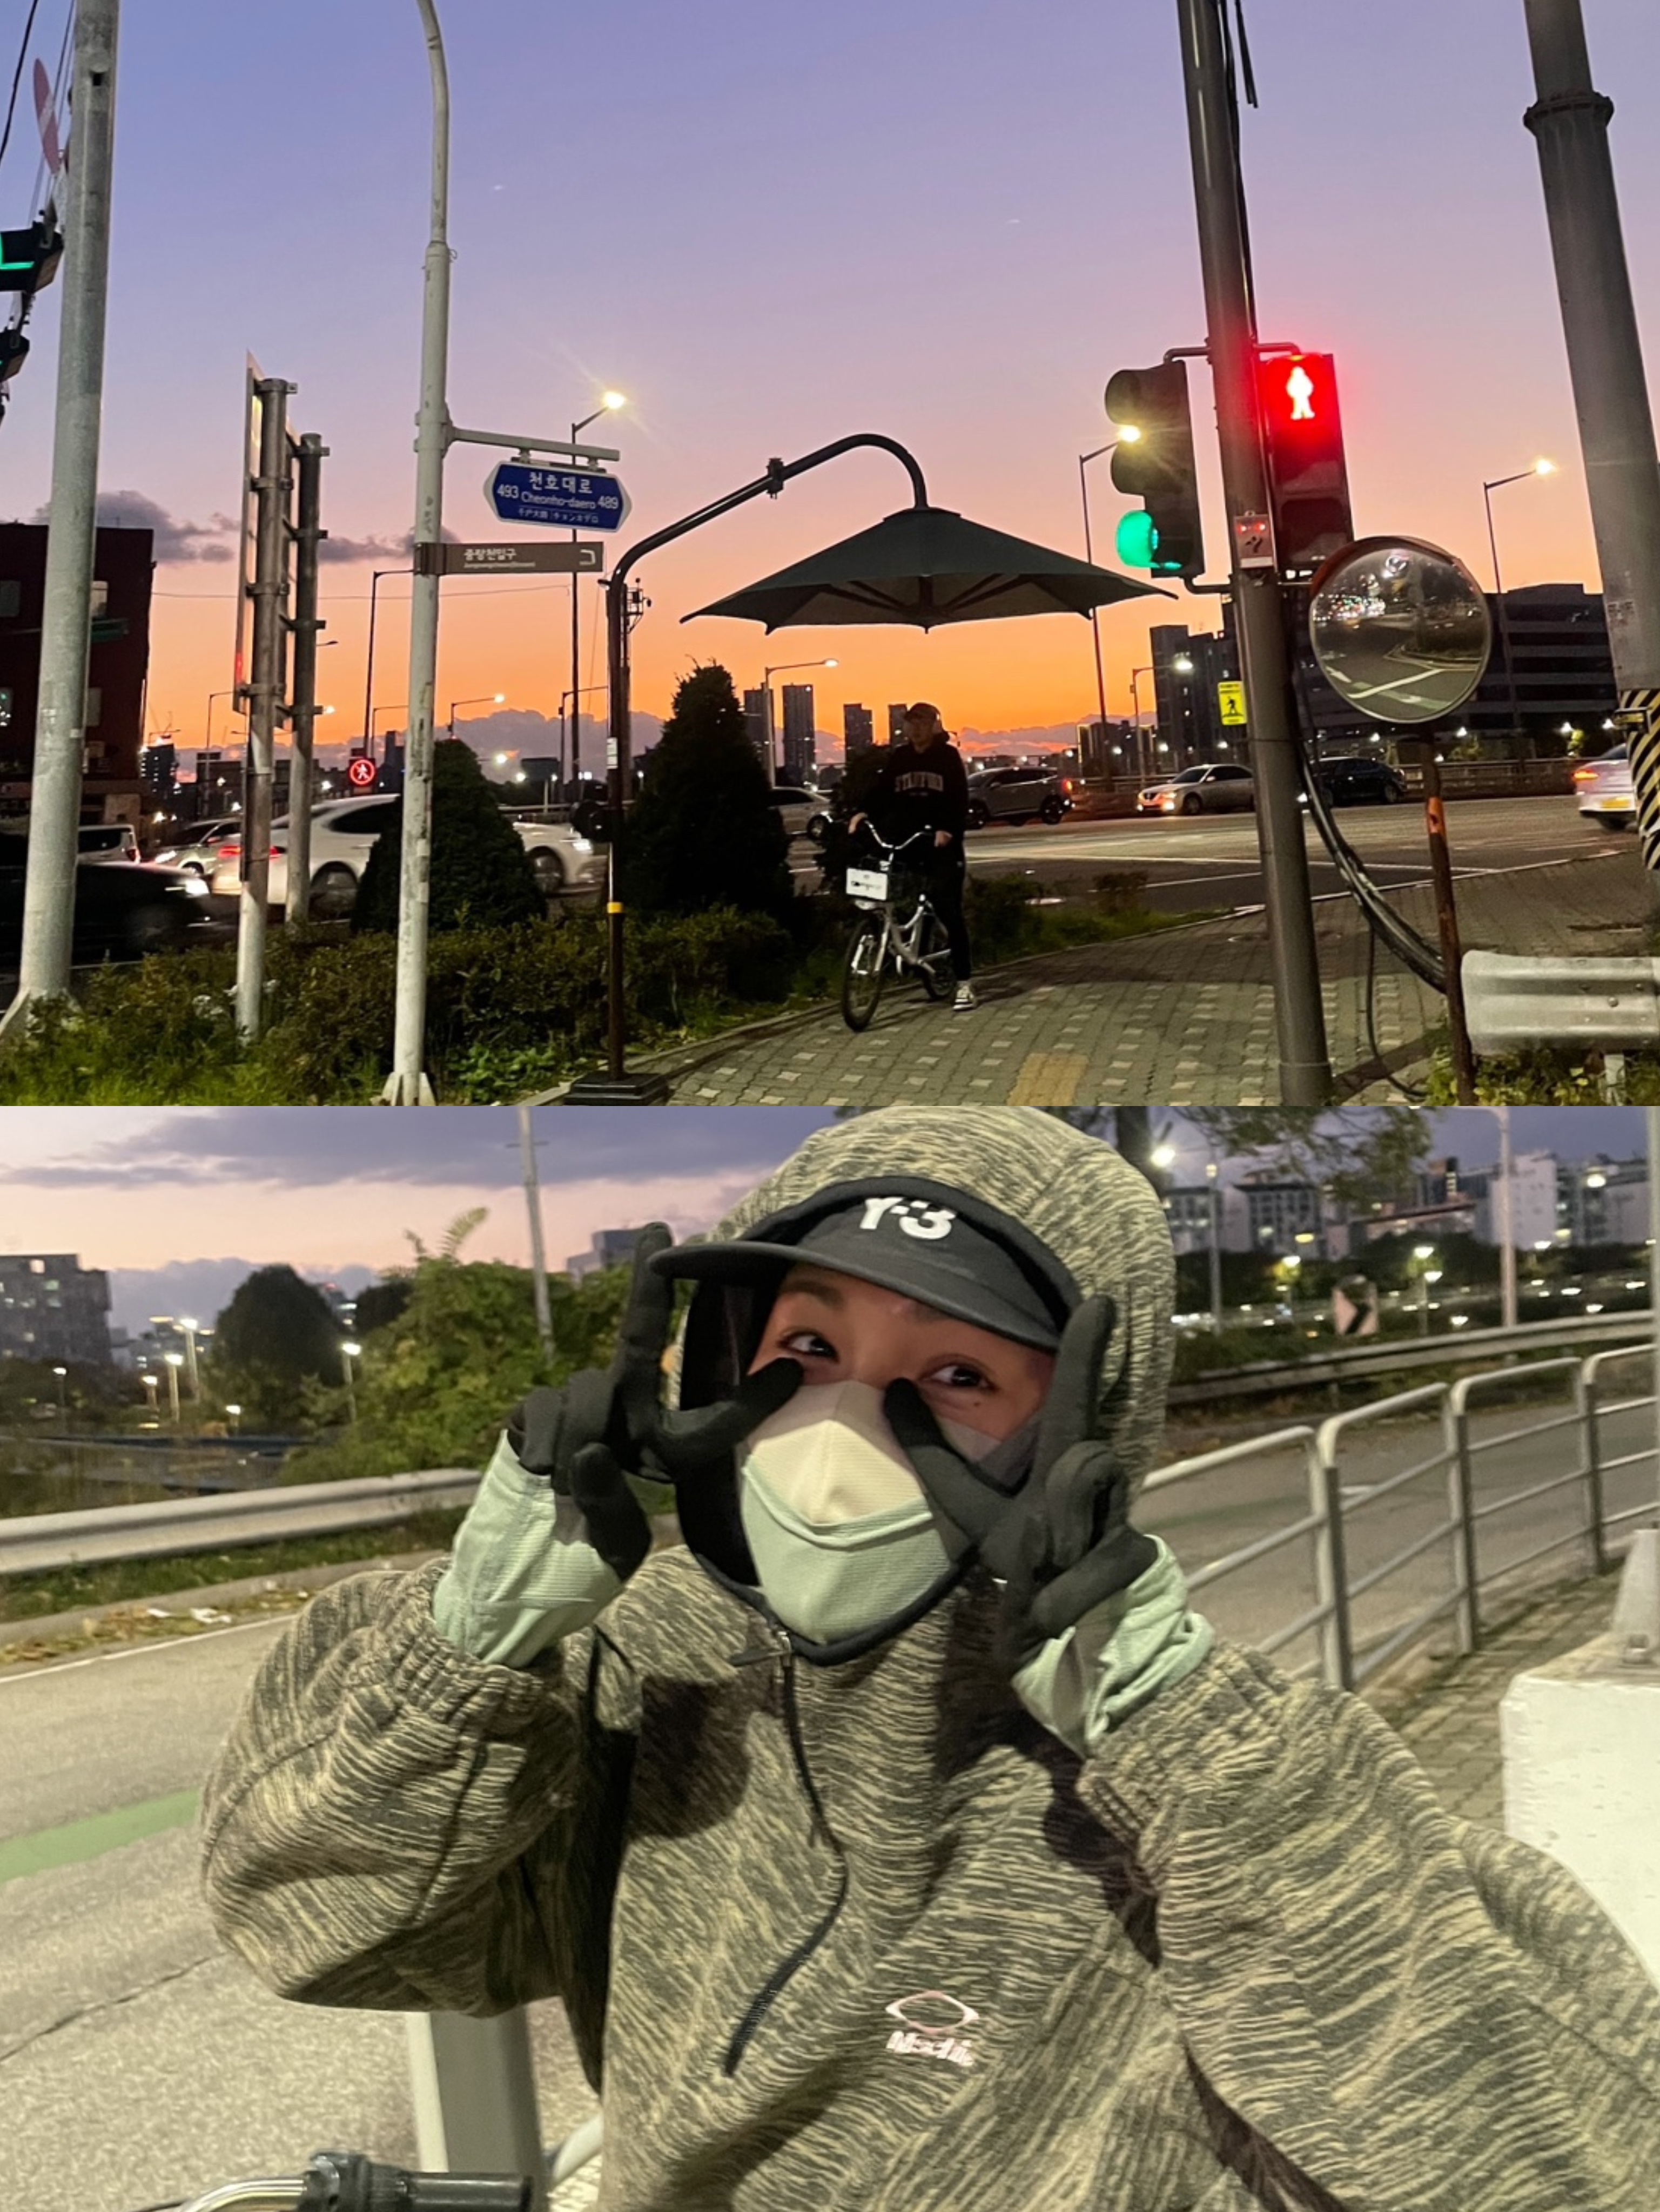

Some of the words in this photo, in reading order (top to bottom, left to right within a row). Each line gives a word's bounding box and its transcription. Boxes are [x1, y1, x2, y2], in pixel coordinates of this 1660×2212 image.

[529, 471, 593, 494] 천호대로
[496, 484, 519, 498] 493
[521, 491, 596, 509] Cheonho-daero
[597, 495, 619, 509] 489
